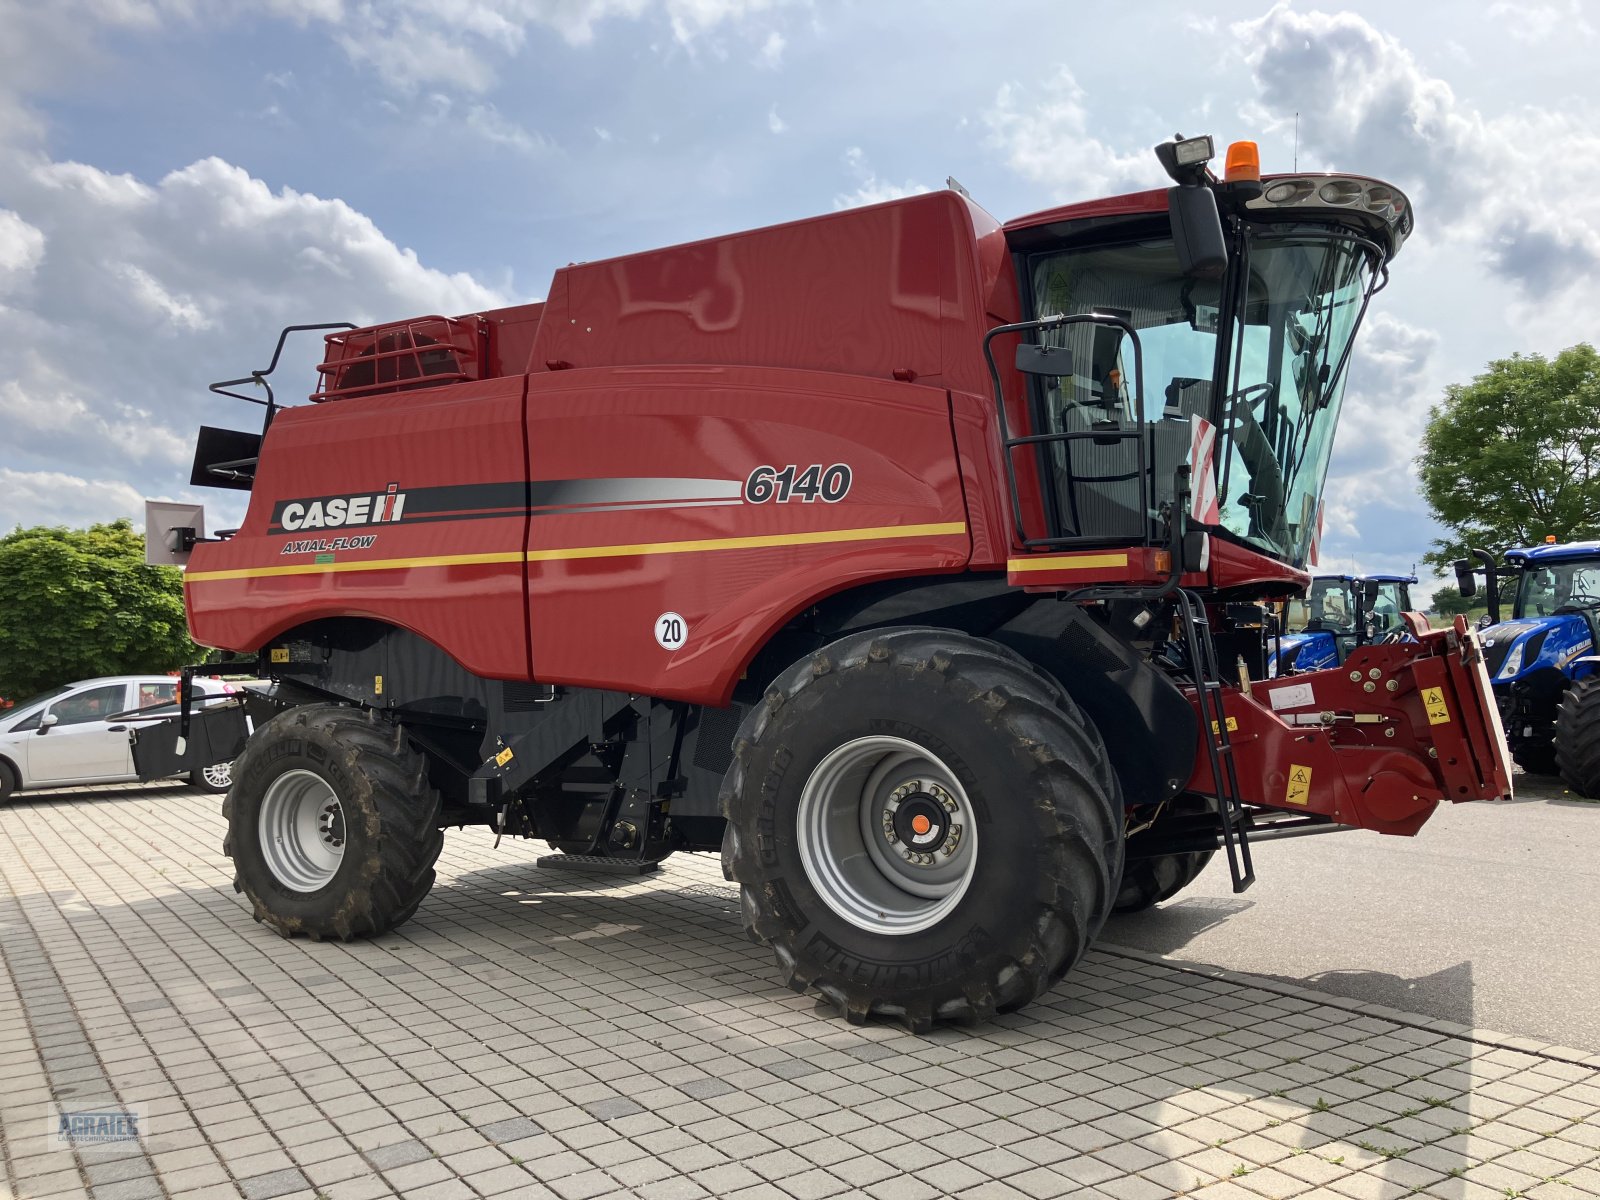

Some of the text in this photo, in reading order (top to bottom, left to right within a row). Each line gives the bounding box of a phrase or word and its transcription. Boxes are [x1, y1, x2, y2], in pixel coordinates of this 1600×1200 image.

[745, 463, 852, 504] 6140
[281, 497, 371, 531] CASE
[280, 535, 377, 555] AXIAL-FLOW
[662, 619, 681, 643] 20
